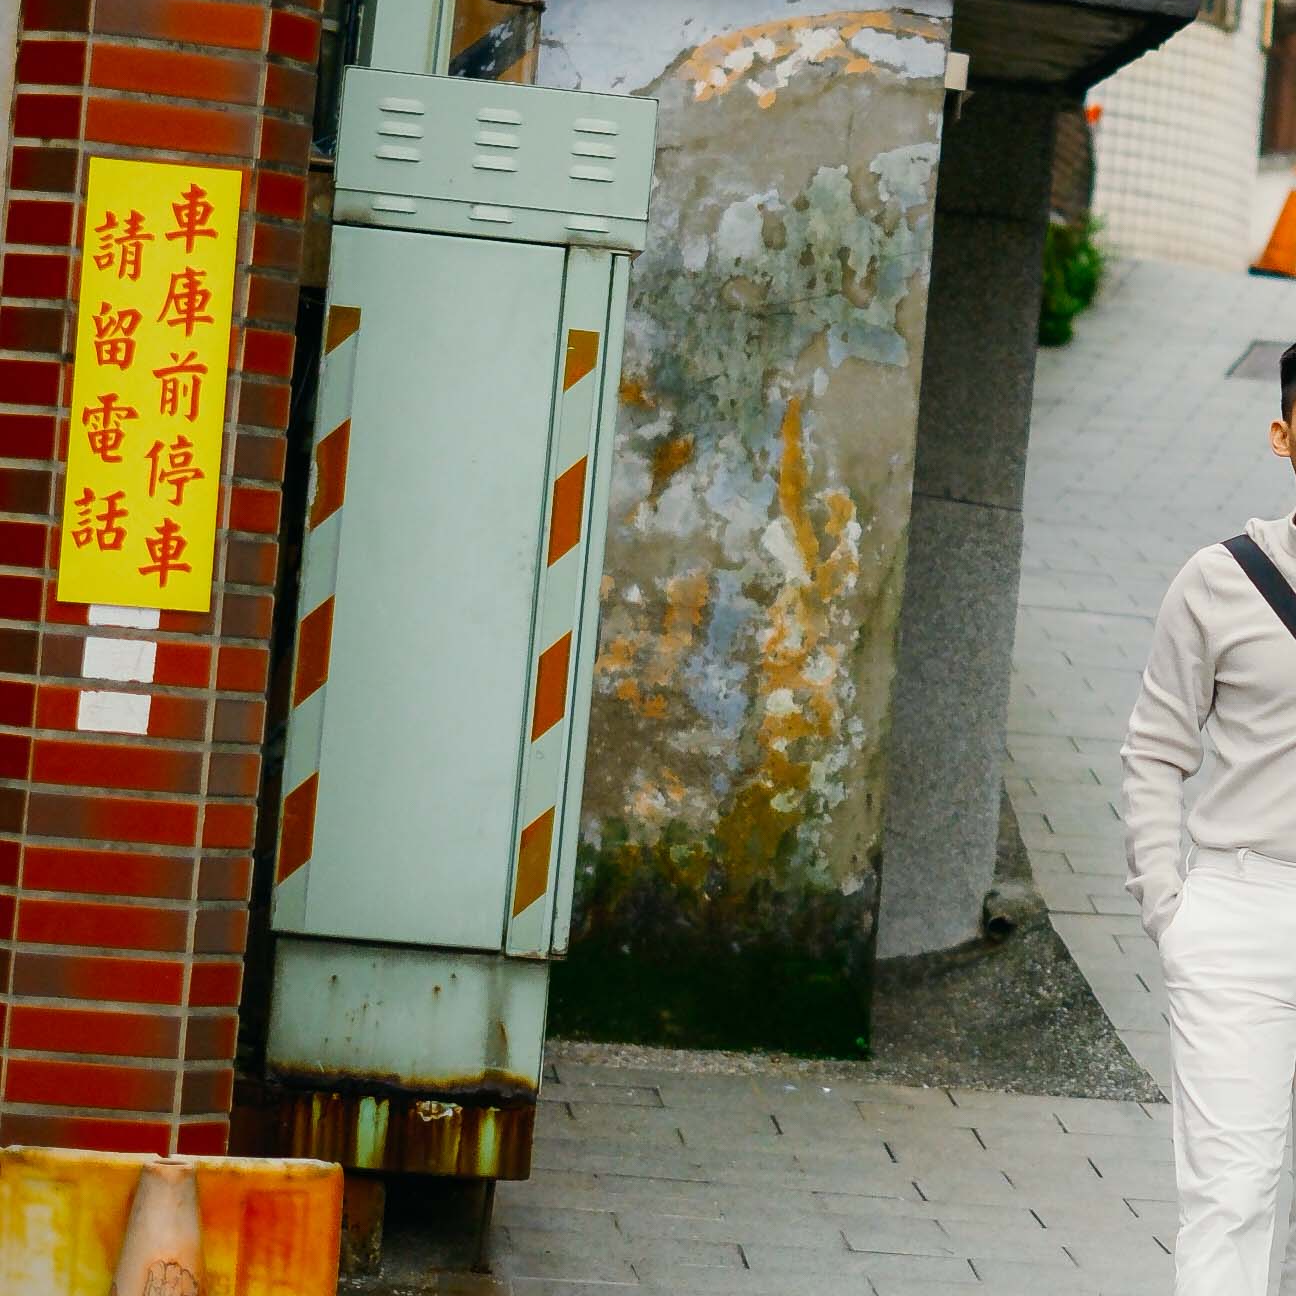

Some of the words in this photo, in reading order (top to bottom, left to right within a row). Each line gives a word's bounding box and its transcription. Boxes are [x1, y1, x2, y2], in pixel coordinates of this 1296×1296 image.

[72, 209, 154, 552] 請留電話
[139, 183, 218, 588] 車庫前停車
